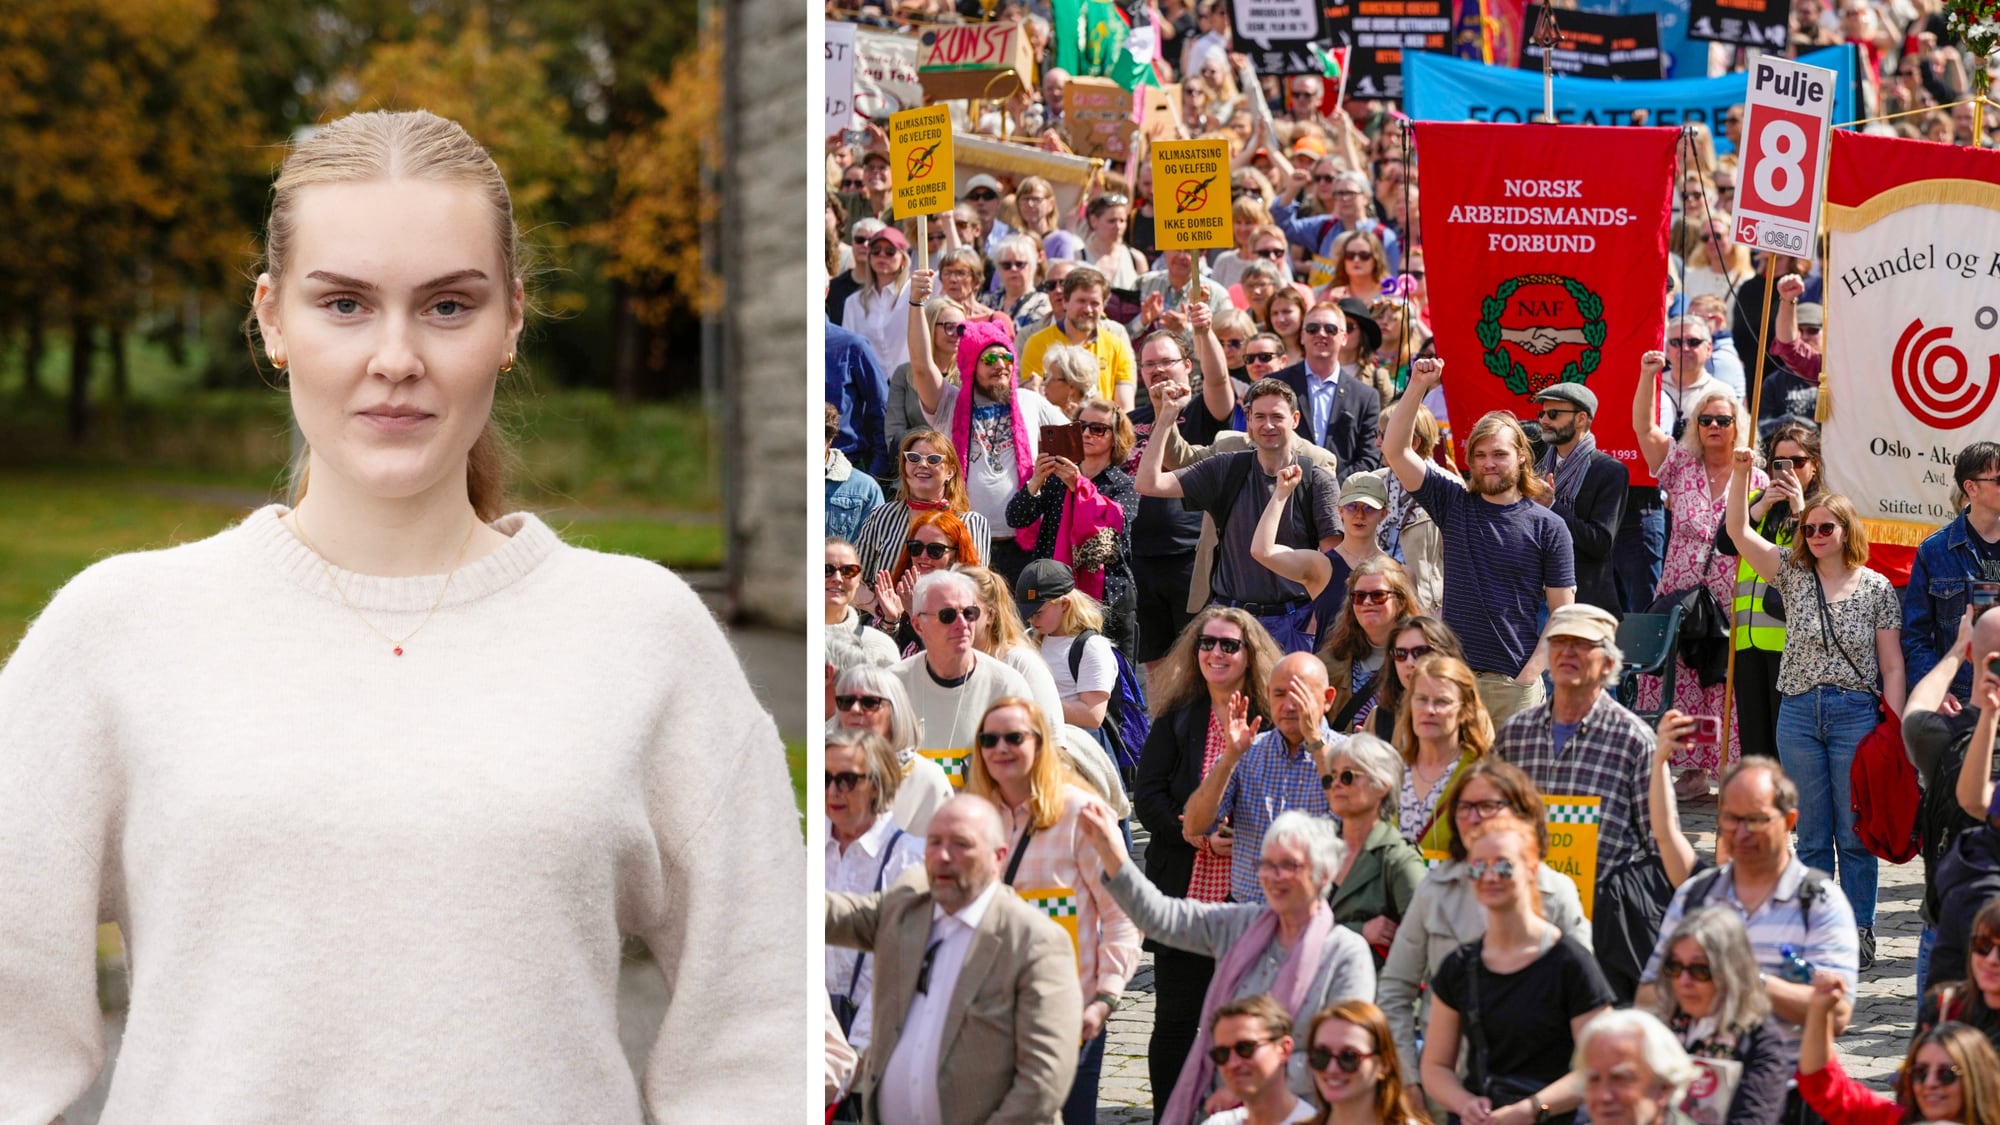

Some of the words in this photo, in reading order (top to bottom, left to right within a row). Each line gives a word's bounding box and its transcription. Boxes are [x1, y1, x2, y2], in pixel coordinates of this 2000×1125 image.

[825, 41, 849, 61] ST
[927, 24, 1017, 65] KUNST
[1755, 63, 1824, 107] Pulje
[895, 113, 945, 131] KLIMASATSING
[899, 133, 908, 144] OG
[910, 128, 942, 142] VELFERD
[1158, 148, 1222, 160] KLIMASATSING
[1753, 119, 1807, 207] 8
[1164, 164, 1177, 174] OG
[1179, 162, 1217, 174] VELFERD
[898, 186, 914, 198] IKKE
[916, 182, 947, 195] BOMBER
[1504, 179, 1583, 198] NORSK
[907, 198, 917, 209] OG
[919, 196, 937, 207] KRIG
[1164, 219, 1185, 229] IKKE
[1188, 217, 1224, 228] BOMBER
[1447, 205, 1637, 226] ARBEIDSMANDS-
[1176, 232, 1189, 242] OG
[1191, 230, 1212, 240] KRIG
[1488, 233, 1596, 253] FORBUND
[1764, 230, 1803, 251] OSLO
[1840, 243, 1936, 298] Handel
[1945, 251, 1981, 279] og
[1518, 301, 1565, 317] NAF
[1611, 450, 1638, 460] 1993
[1870, 437, 1911, 459] Oslo
[1930, 445, 1959, 467] Ake
[1922, 469, 1949, 487] Avd.
[1879, 499, 1922, 515] Stiftet
[1551, 833, 1573, 848] DD
[1546, 857, 1581, 876] EVÅL
